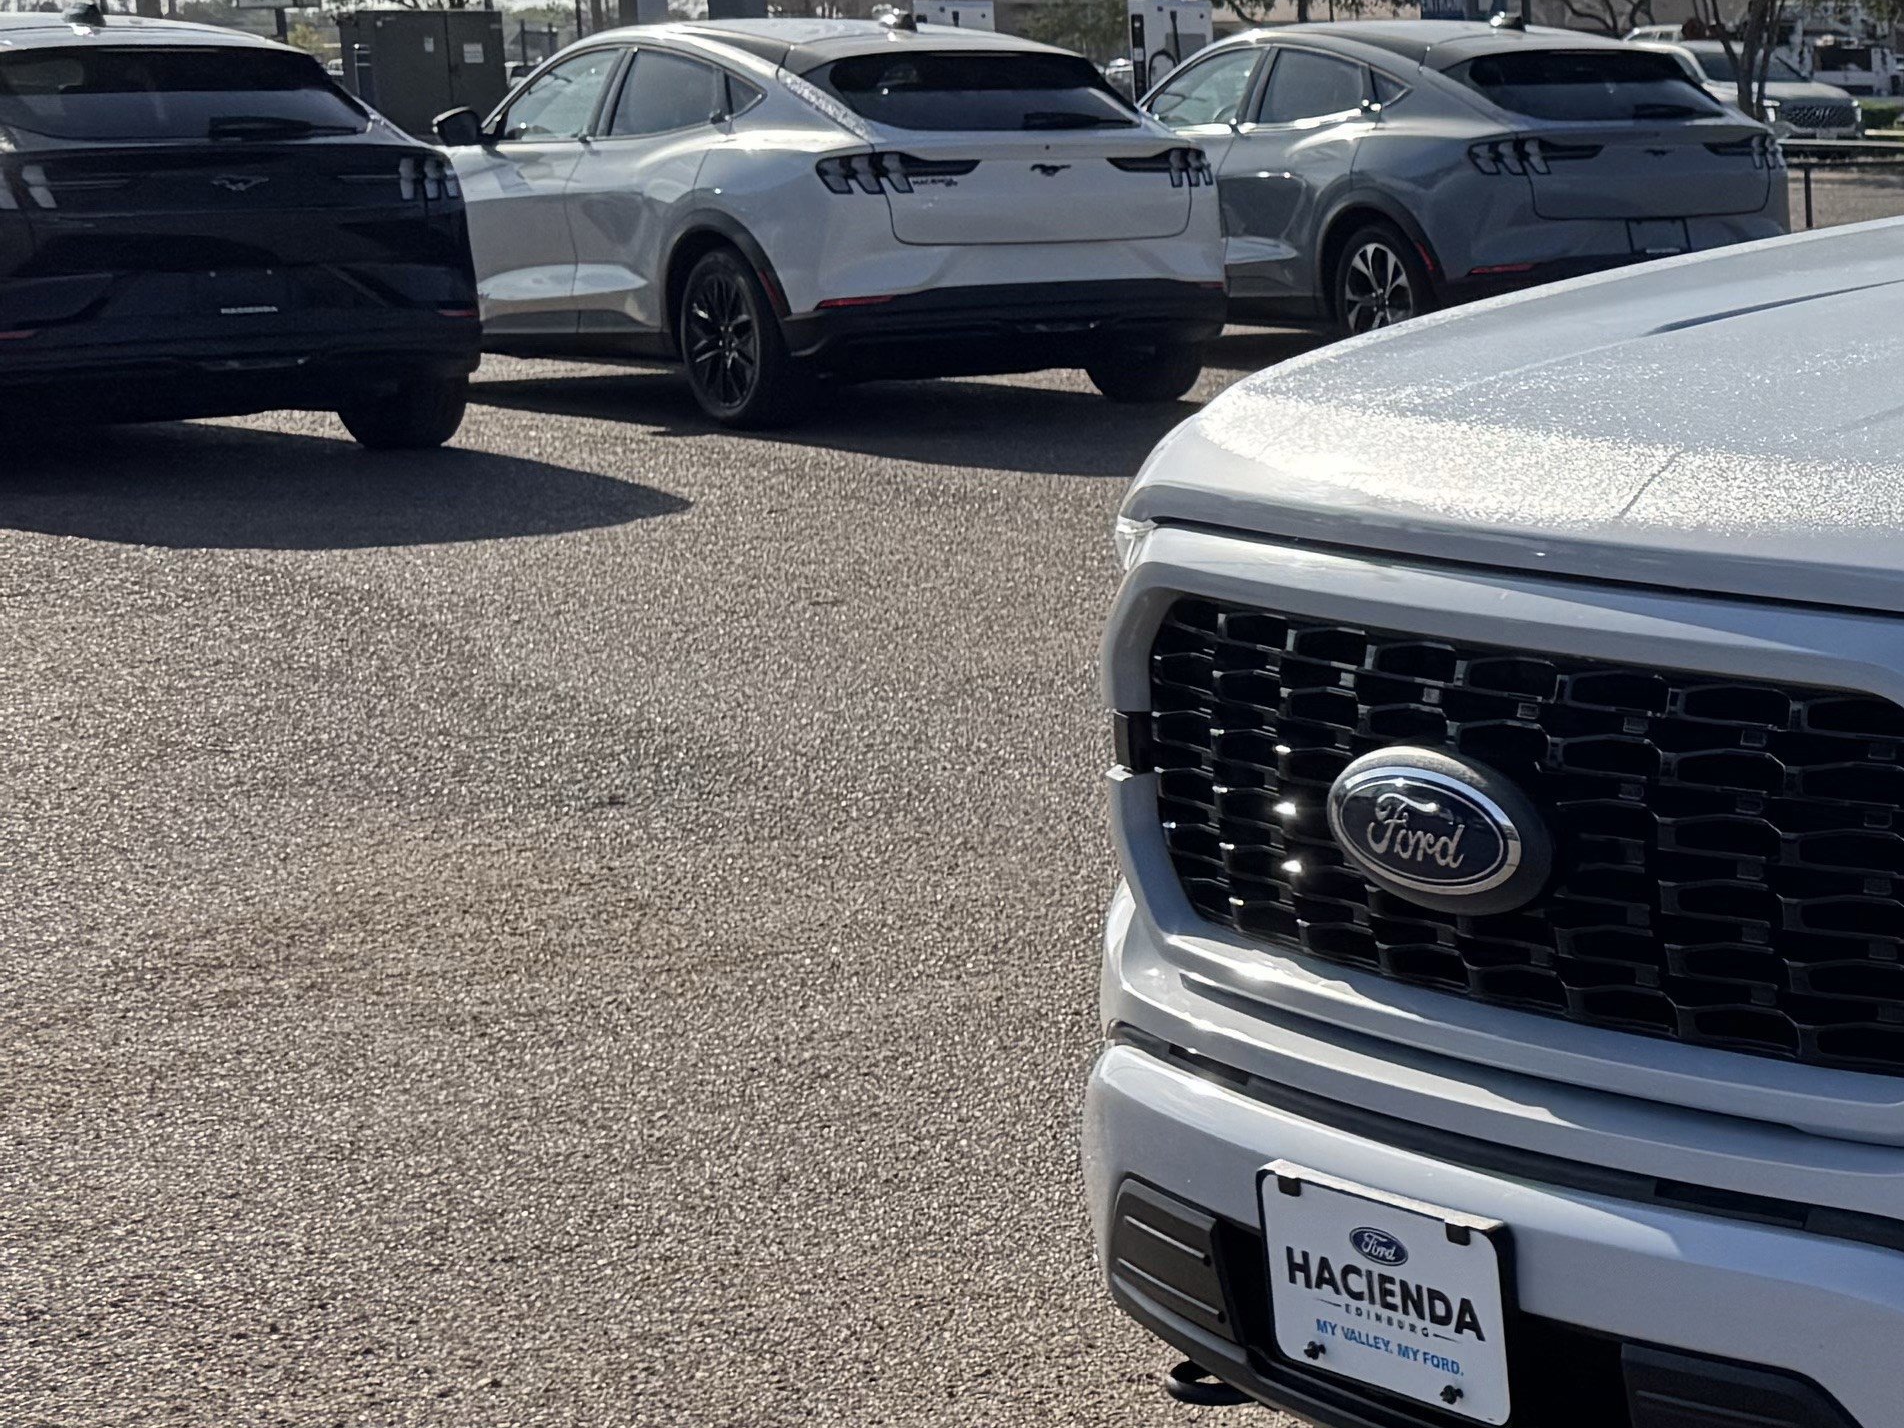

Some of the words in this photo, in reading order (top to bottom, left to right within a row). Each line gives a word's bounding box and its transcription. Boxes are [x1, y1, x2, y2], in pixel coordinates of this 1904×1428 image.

[1366, 791, 1466, 870] Ford
[1360, 1231, 1397, 1262] Ford
[1285, 1245, 1486, 1342] HACIENDA
[1344, 1303, 1430, 1338] EDINBURG
[1316, 1319, 1337, 1337] MY
[1341, 1325, 1394, 1355] VALLEY.
[1397, 1343, 1420, 1362] MY
[1423, 1351, 1465, 1377] FORD.
